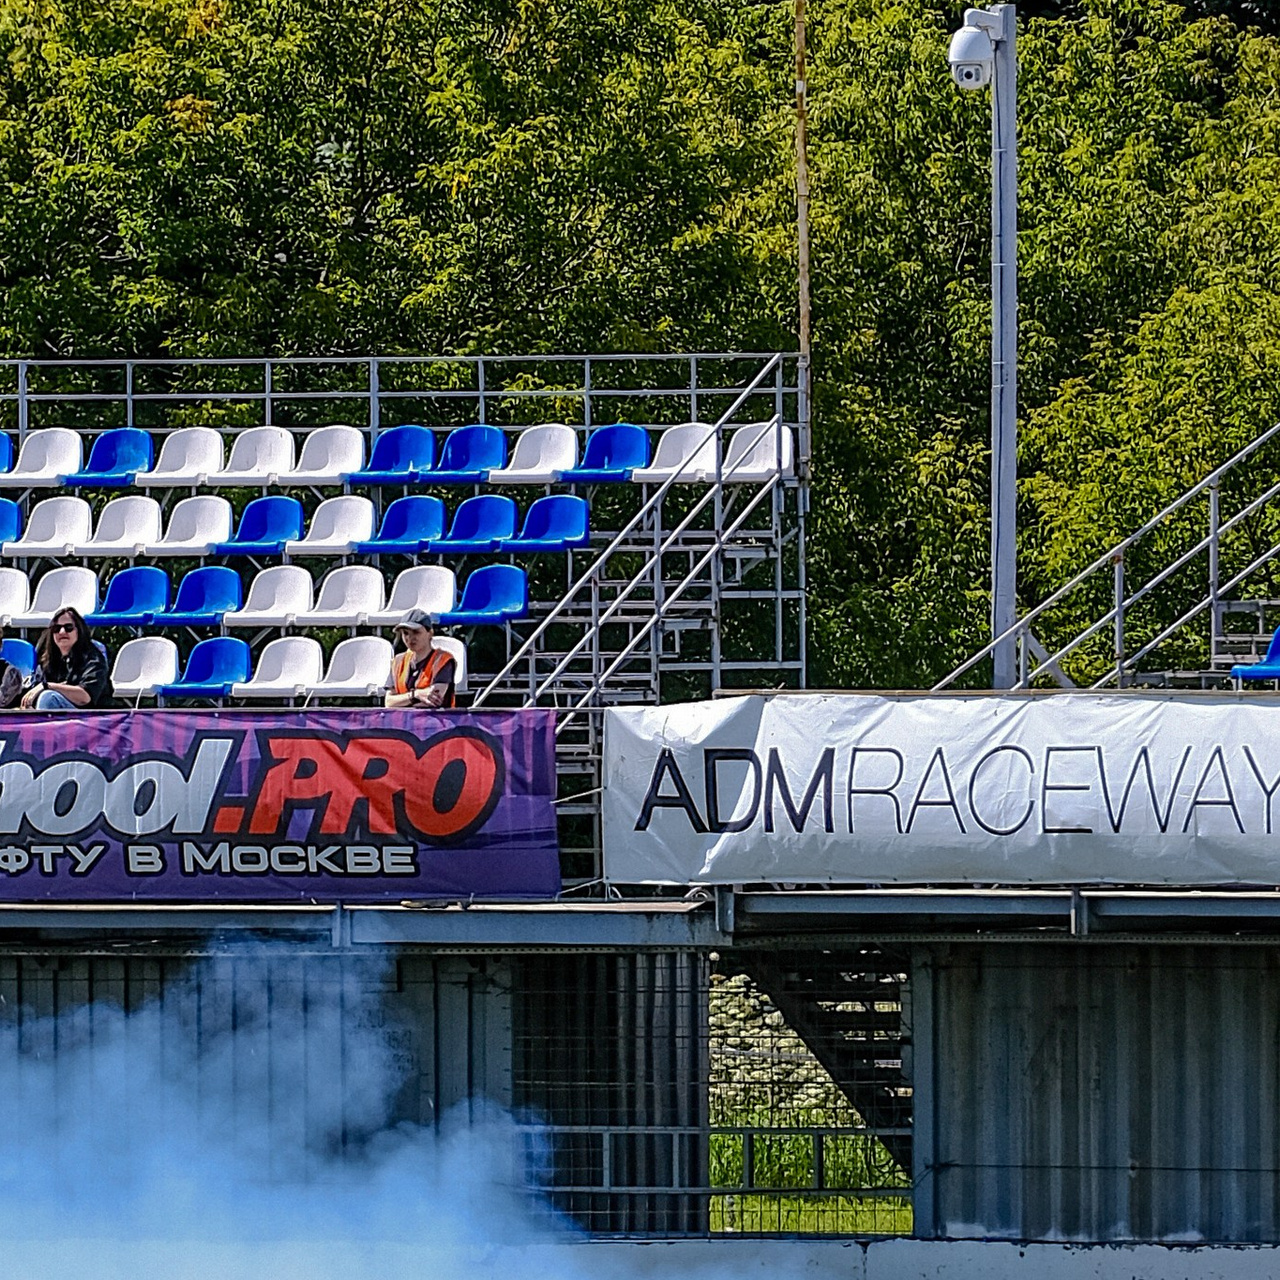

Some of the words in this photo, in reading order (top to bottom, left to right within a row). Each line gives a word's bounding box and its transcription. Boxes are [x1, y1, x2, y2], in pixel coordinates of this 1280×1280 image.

[634, 743, 1280, 836] ADMRACEWAY
[128, 845, 163, 873] В
[183, 842, 415, 873] МОСКВЕ
